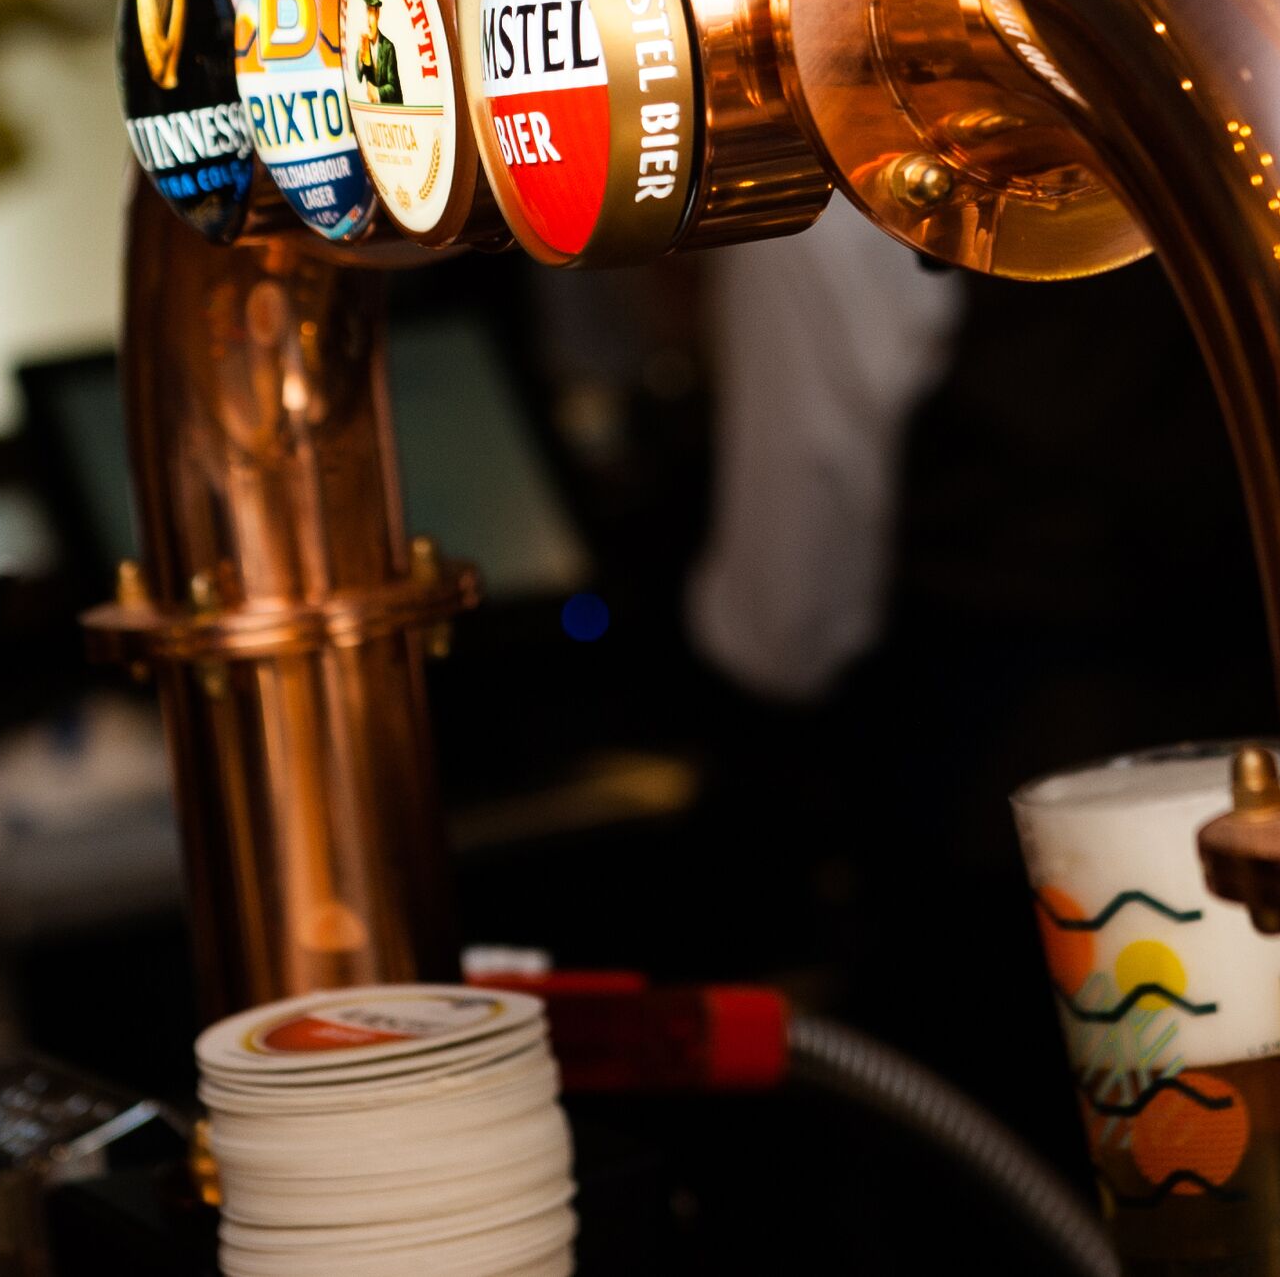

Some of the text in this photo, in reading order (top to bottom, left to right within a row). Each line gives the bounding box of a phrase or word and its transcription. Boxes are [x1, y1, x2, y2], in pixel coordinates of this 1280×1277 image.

[482, 0, 601, 82] MSTEL
[126, 101, 254, 173] UINNESS
[247, 87, 355, 149] RIXTO
[493, 110, 563, 167] BIER
[634, 101, 681, 204] BIER
[298, 184, 338, 212] LAGER
